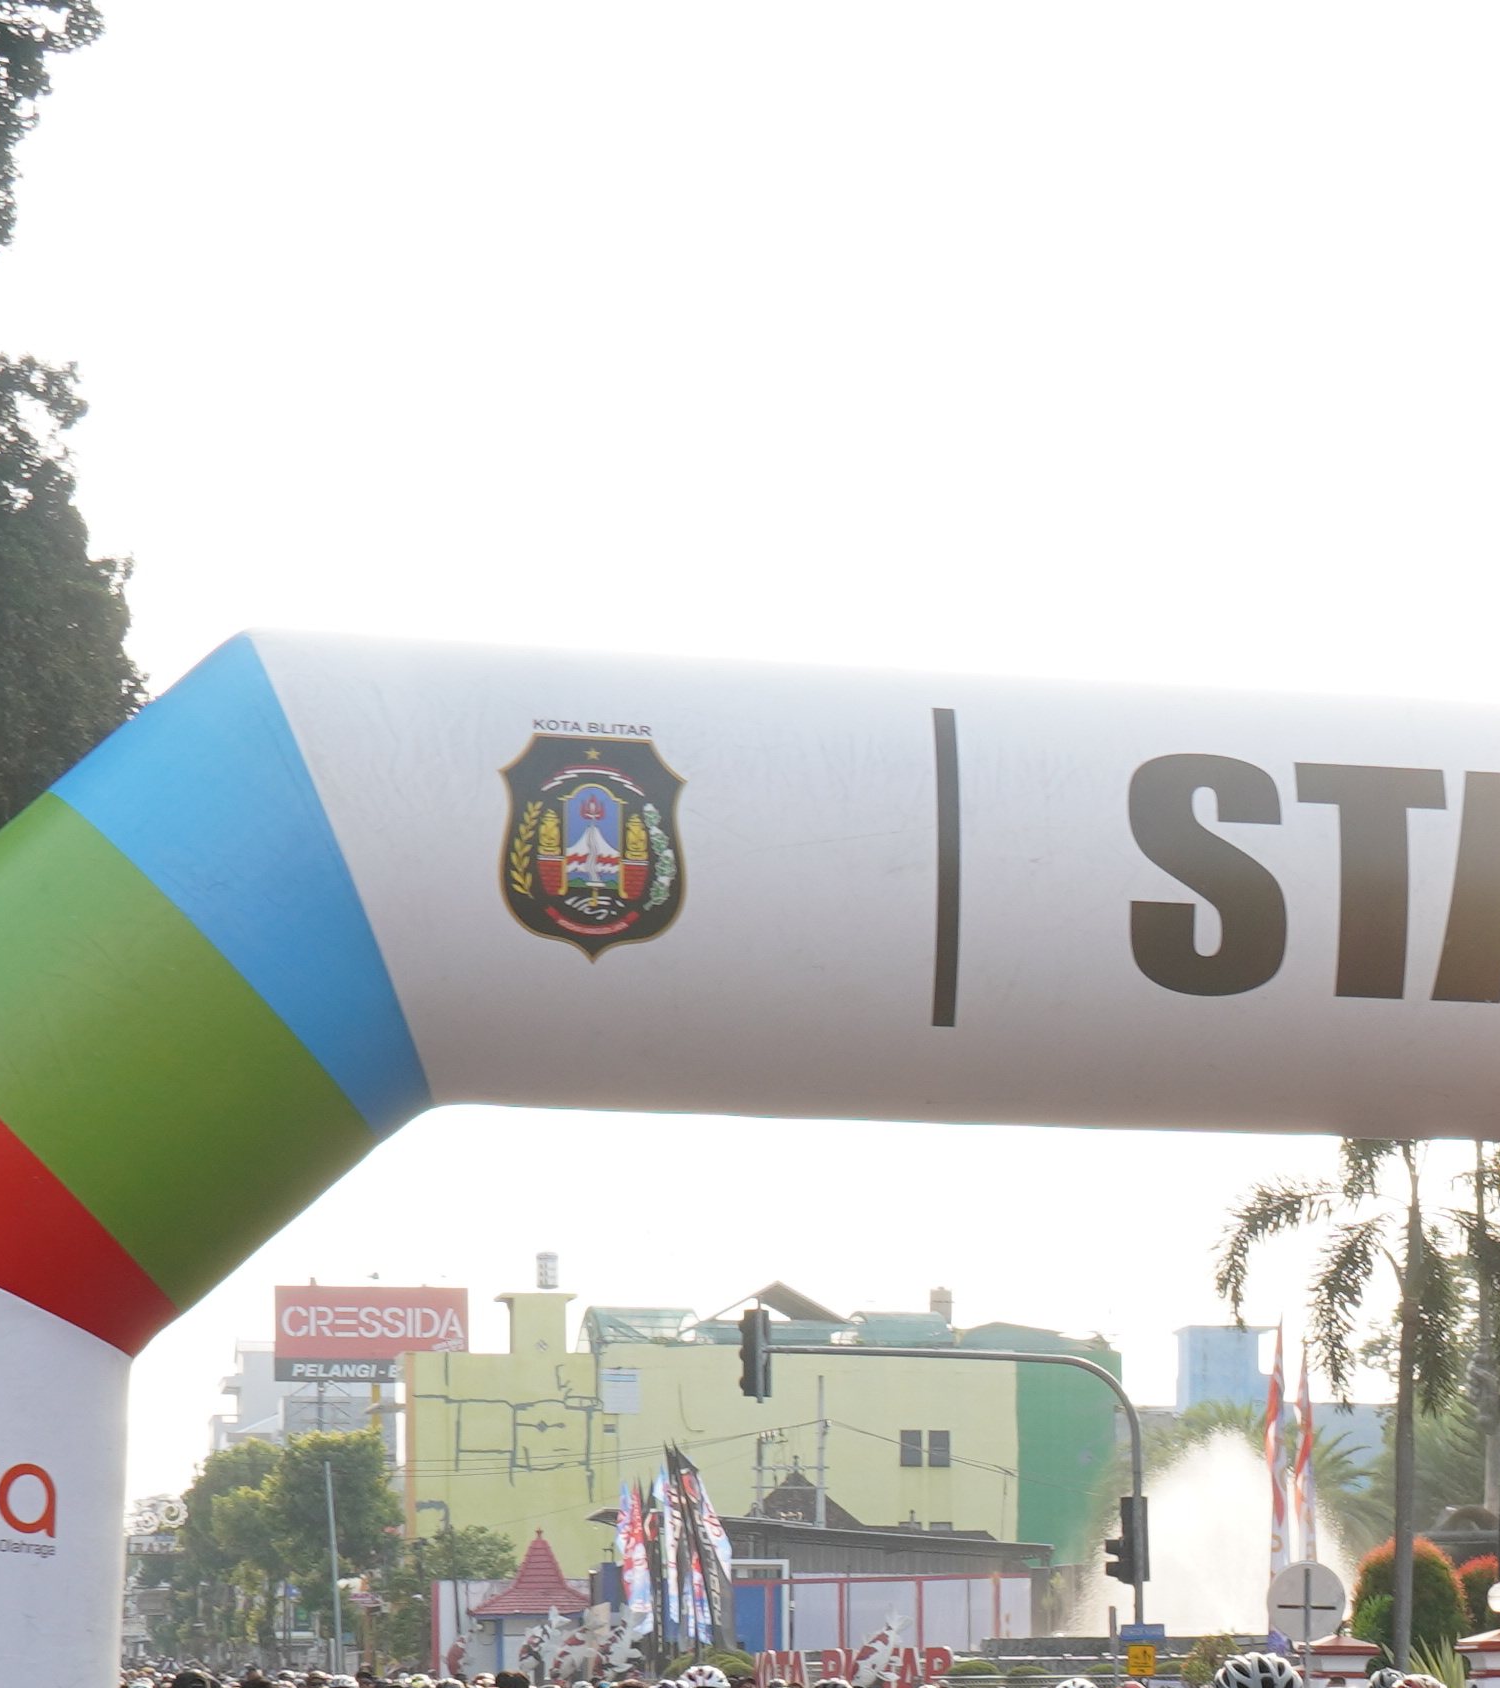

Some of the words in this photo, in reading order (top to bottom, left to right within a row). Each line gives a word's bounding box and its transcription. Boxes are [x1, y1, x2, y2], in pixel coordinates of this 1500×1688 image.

[533, 719, 583, 733] KOTA
[587, 722, 652, 737] BLITAR
[281, 1305, 465, 1339] CRESSIDA
[292, 1363, 377, 1378] PELANGI
